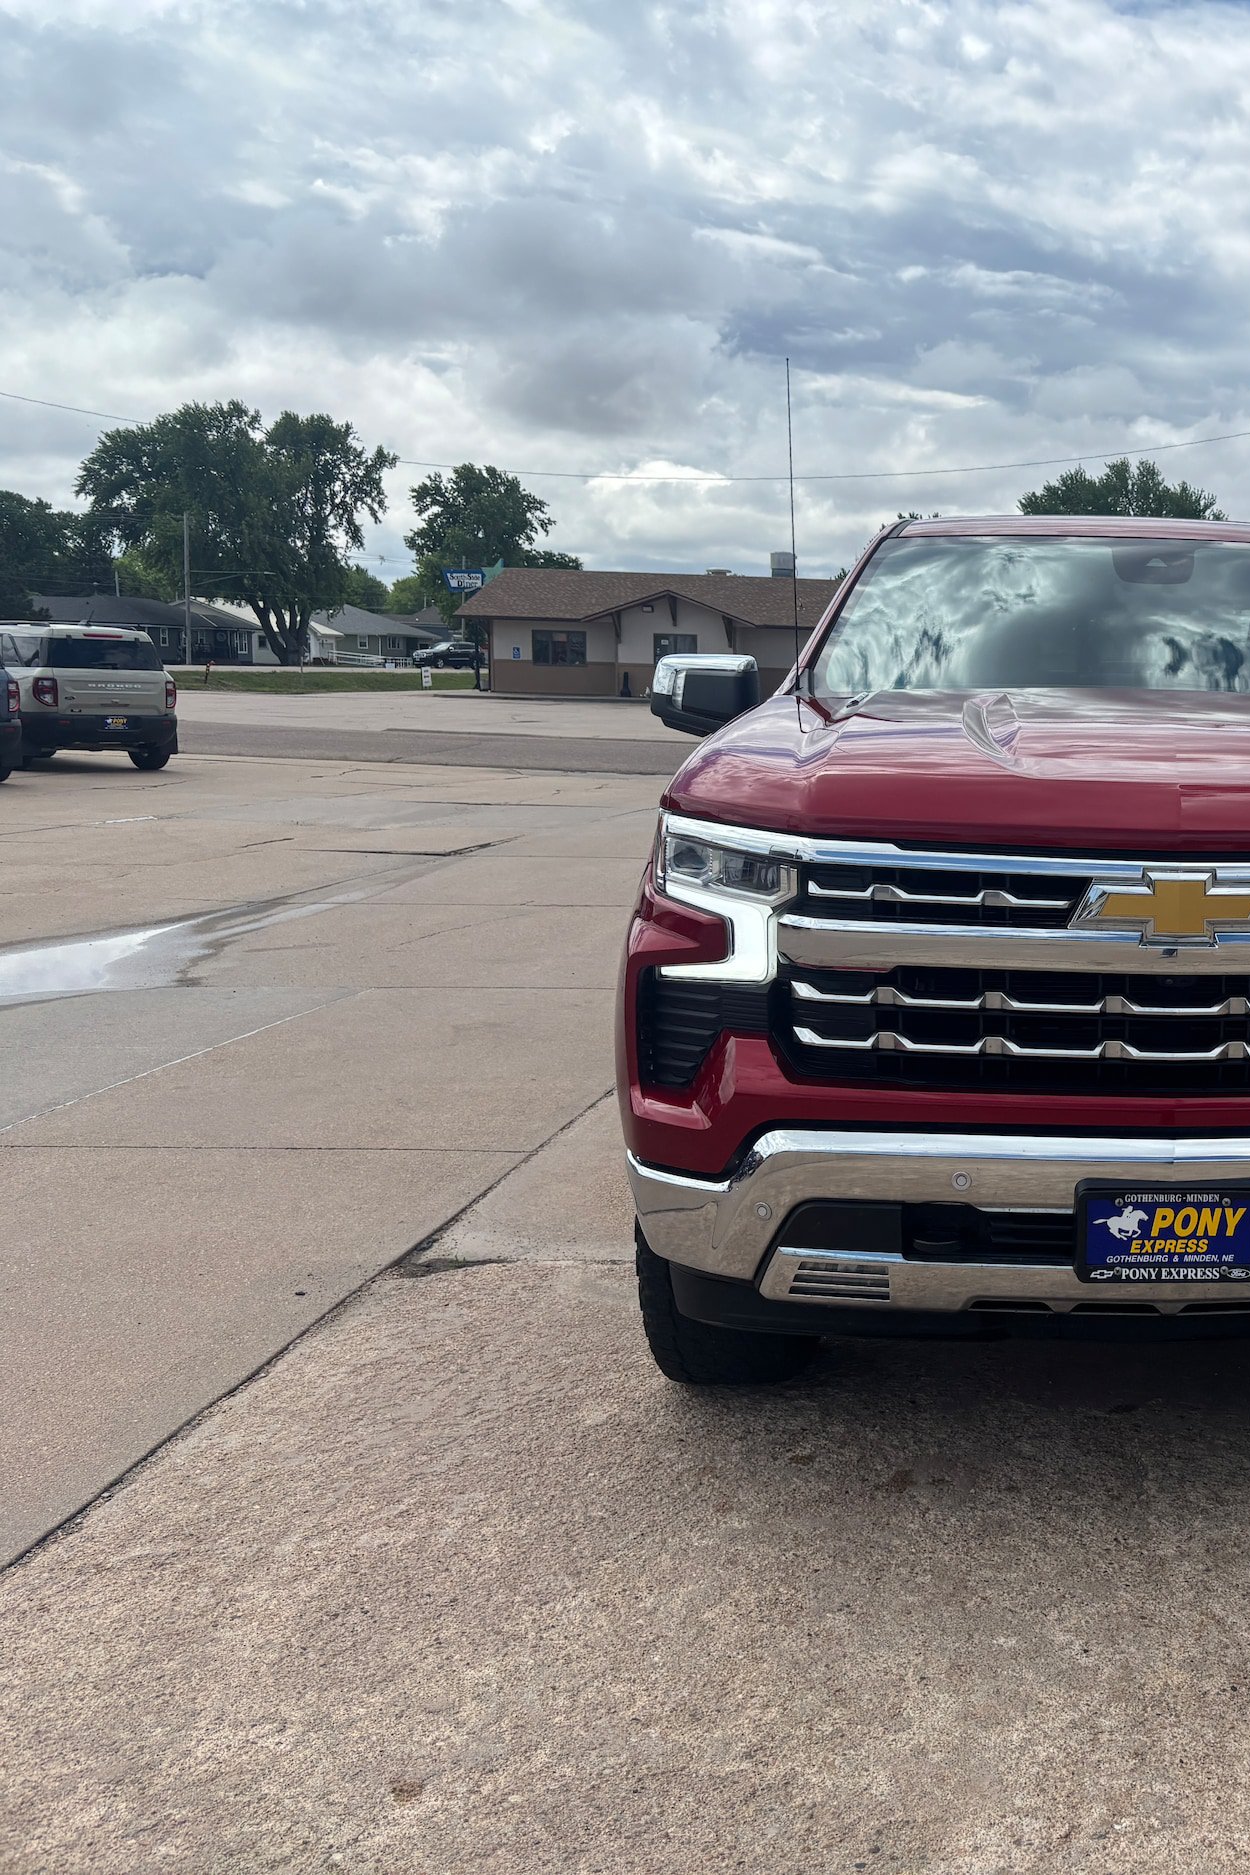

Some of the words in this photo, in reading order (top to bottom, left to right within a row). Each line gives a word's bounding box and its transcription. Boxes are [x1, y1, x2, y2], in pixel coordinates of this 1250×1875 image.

[1150, 1207, 1247, 1237] PONY
[1130, 1239, 1209, 1253] EXPRESS
[1106, 1255, 1169, 1263] GOTHENBURG
[1183, 1255, 1220, 1263] MINDEN,
[1221, 1254, 1235, 1262] NE
[1121, 1268, 1158, 1280] PONY
[1160, 1268, 1220, 1280] EXPRESS
